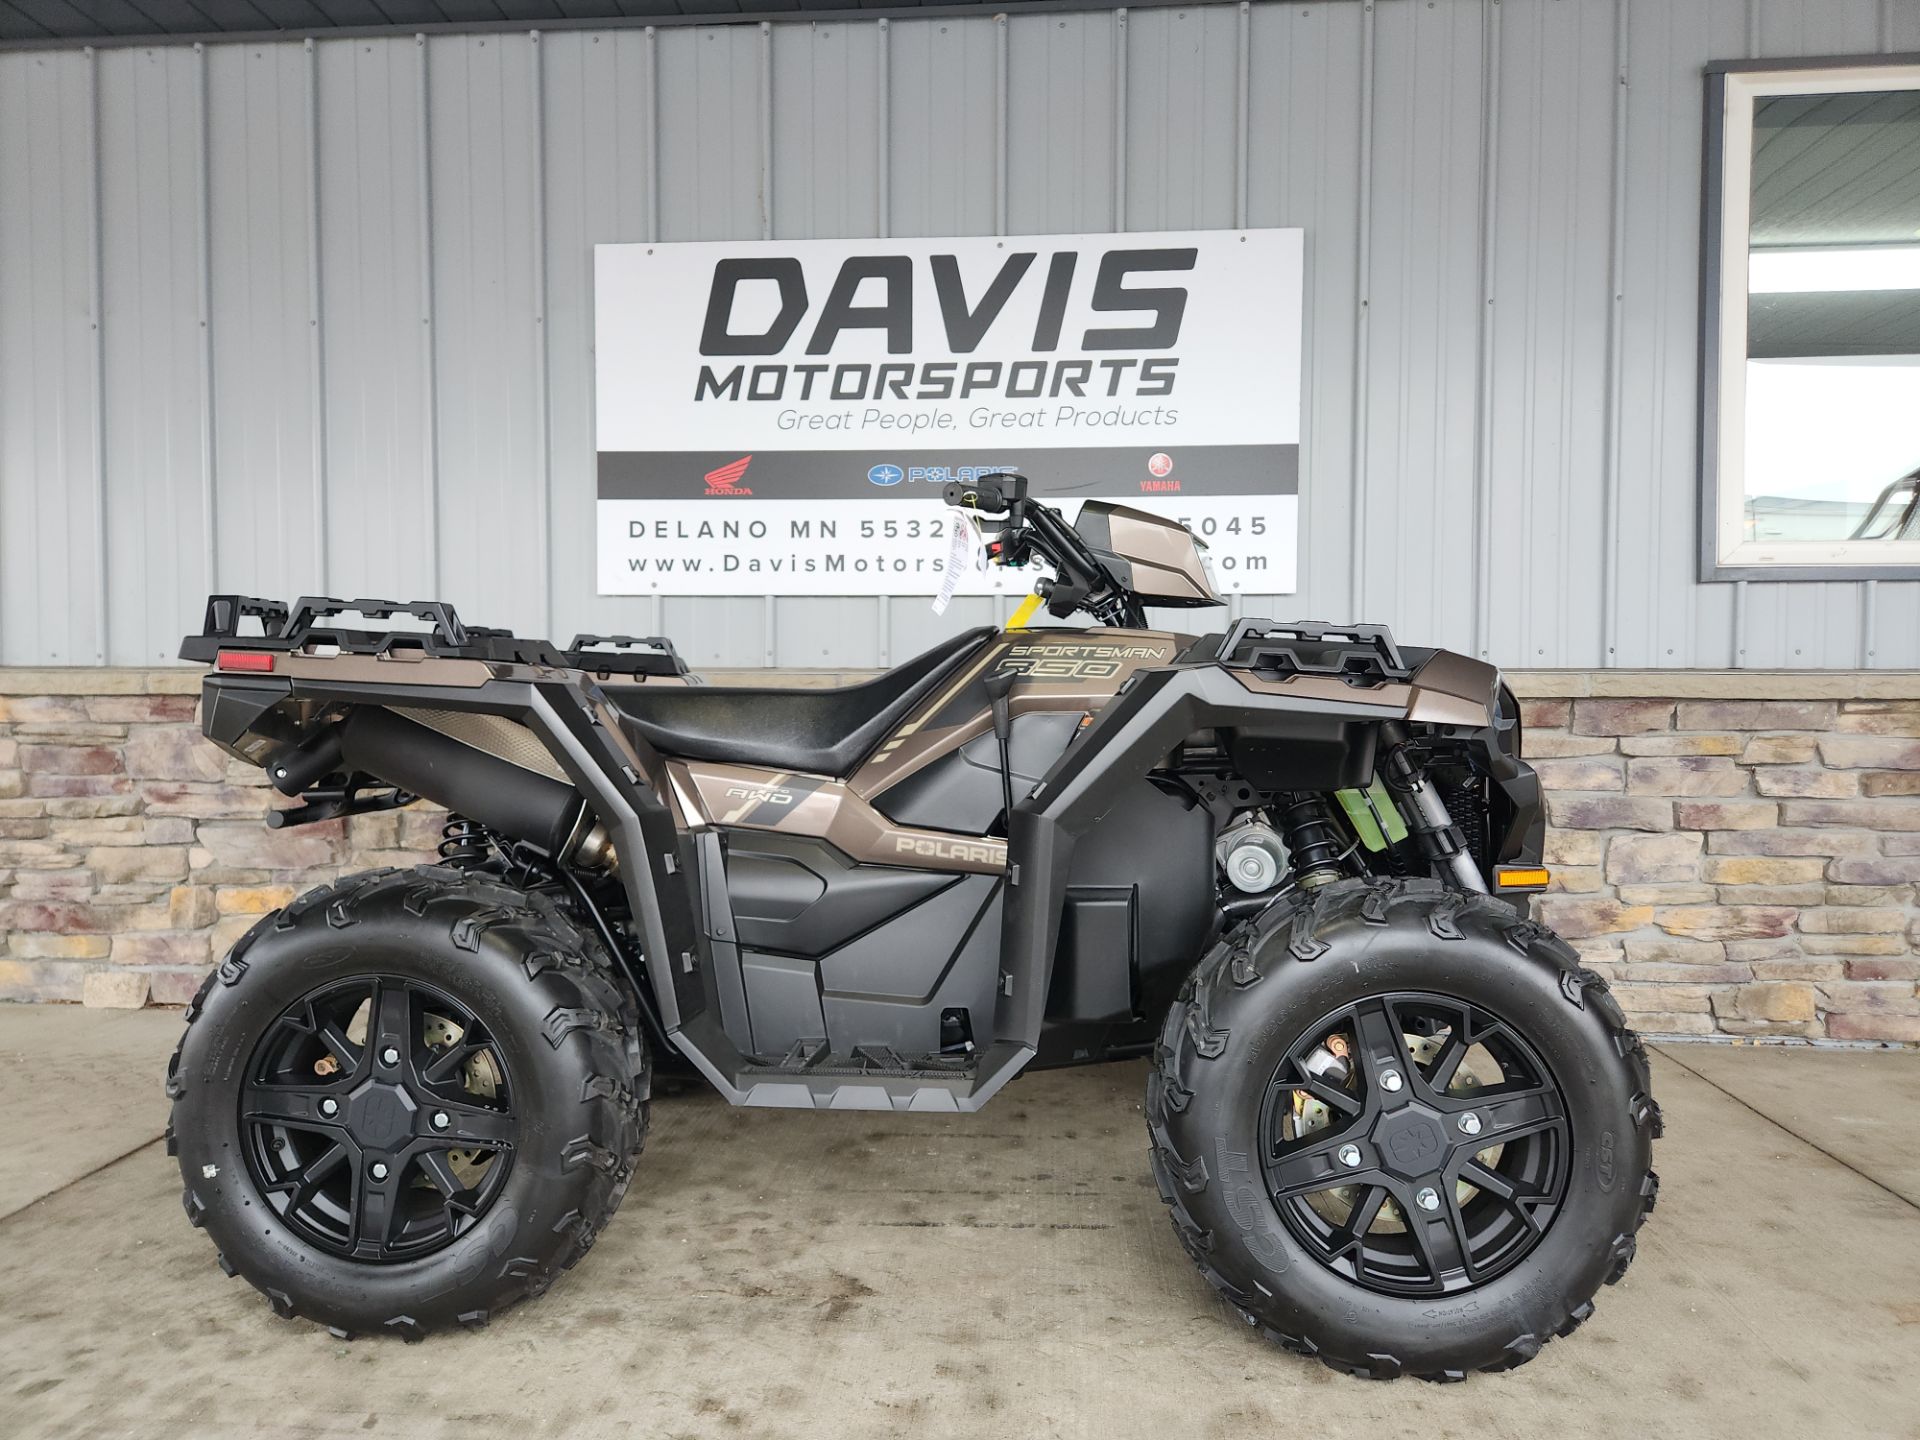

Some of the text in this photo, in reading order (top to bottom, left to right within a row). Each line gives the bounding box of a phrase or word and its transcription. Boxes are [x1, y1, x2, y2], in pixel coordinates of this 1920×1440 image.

[699, 248, 1198, 356] DAVIS
[694, 358, 1180, 401] MOTORSPORTS
[776, 405, 1178, 434] Great People, Great Products
[1140, 480, 1181, 491] YAMAHA
[629, 520, 767, 539] DELANO
[790, 520, 836, 539] MN
[860, 519, 946, 539] 5532
[1009, 645, 1167, 660] SPORTSMAN
[725, 787, 793, 805] AWD
[896, 837, 1007, 866] POLARIS
[1214, 1136, 1290, 1273] CST
